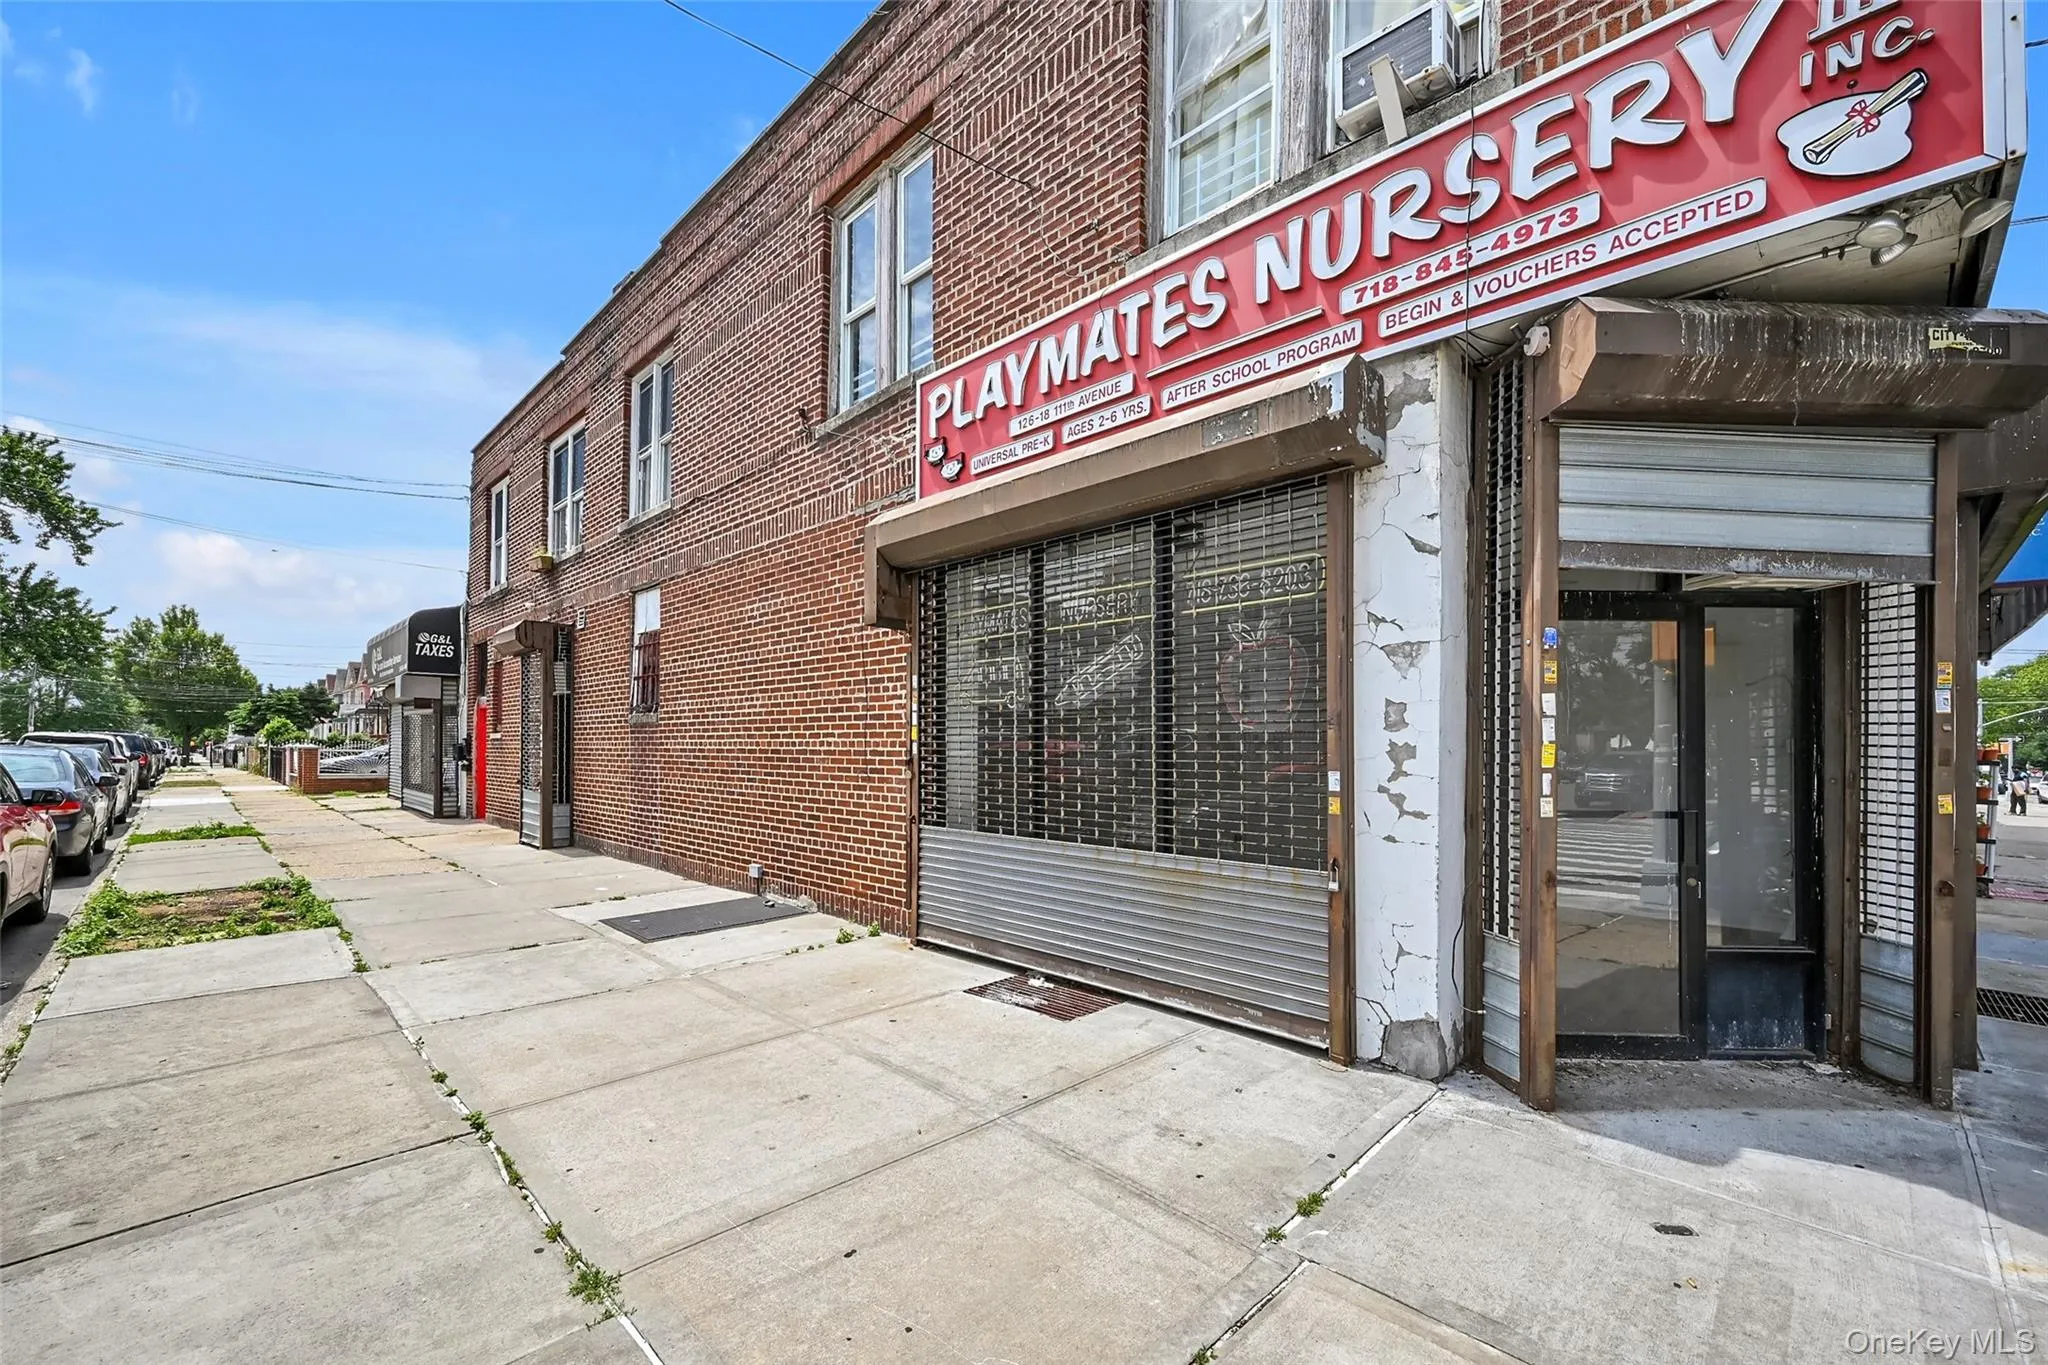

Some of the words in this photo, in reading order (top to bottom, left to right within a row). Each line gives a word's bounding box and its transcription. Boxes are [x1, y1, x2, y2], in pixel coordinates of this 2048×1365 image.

[1799, 15, 1936, 88] INC.
[927, 256, 1229, 439] PLAYMATES
[1253, 0, 1785, 304] NURSERY
[1353, 206, 1580, 304] 718-845-4973
[1385, 298, 1442, 330] BEGIN
[1451, 290, 1464, 307] &
[1473, 244, 1597, 298] VOUCHERS
[1609, 190, 1754, 253] ACCEPTED
[1166, 380, 1206, 404] AFTER
[1212, 358, 1271, 387] SCHOOL
[1277, 327, 1356, 366] PROGRAM
[1018, 411, 1050, 430] 126-18
[1053, 400, 1075, 416] 111th
[1078, 381, 1122, 408] AVENUE
[1067, 422, 1094, 439] AGES
[1098, 414, 1117, 430] 2-6
[1121, 401, 1147, 419] YRS.
[973, 448, 1019, 471] UNIVERSAL
[1022, 435, 1051, 454] PRE-K
[415, 642, 454, 657] TAXES
[430, 633, 452, 644] G&L
